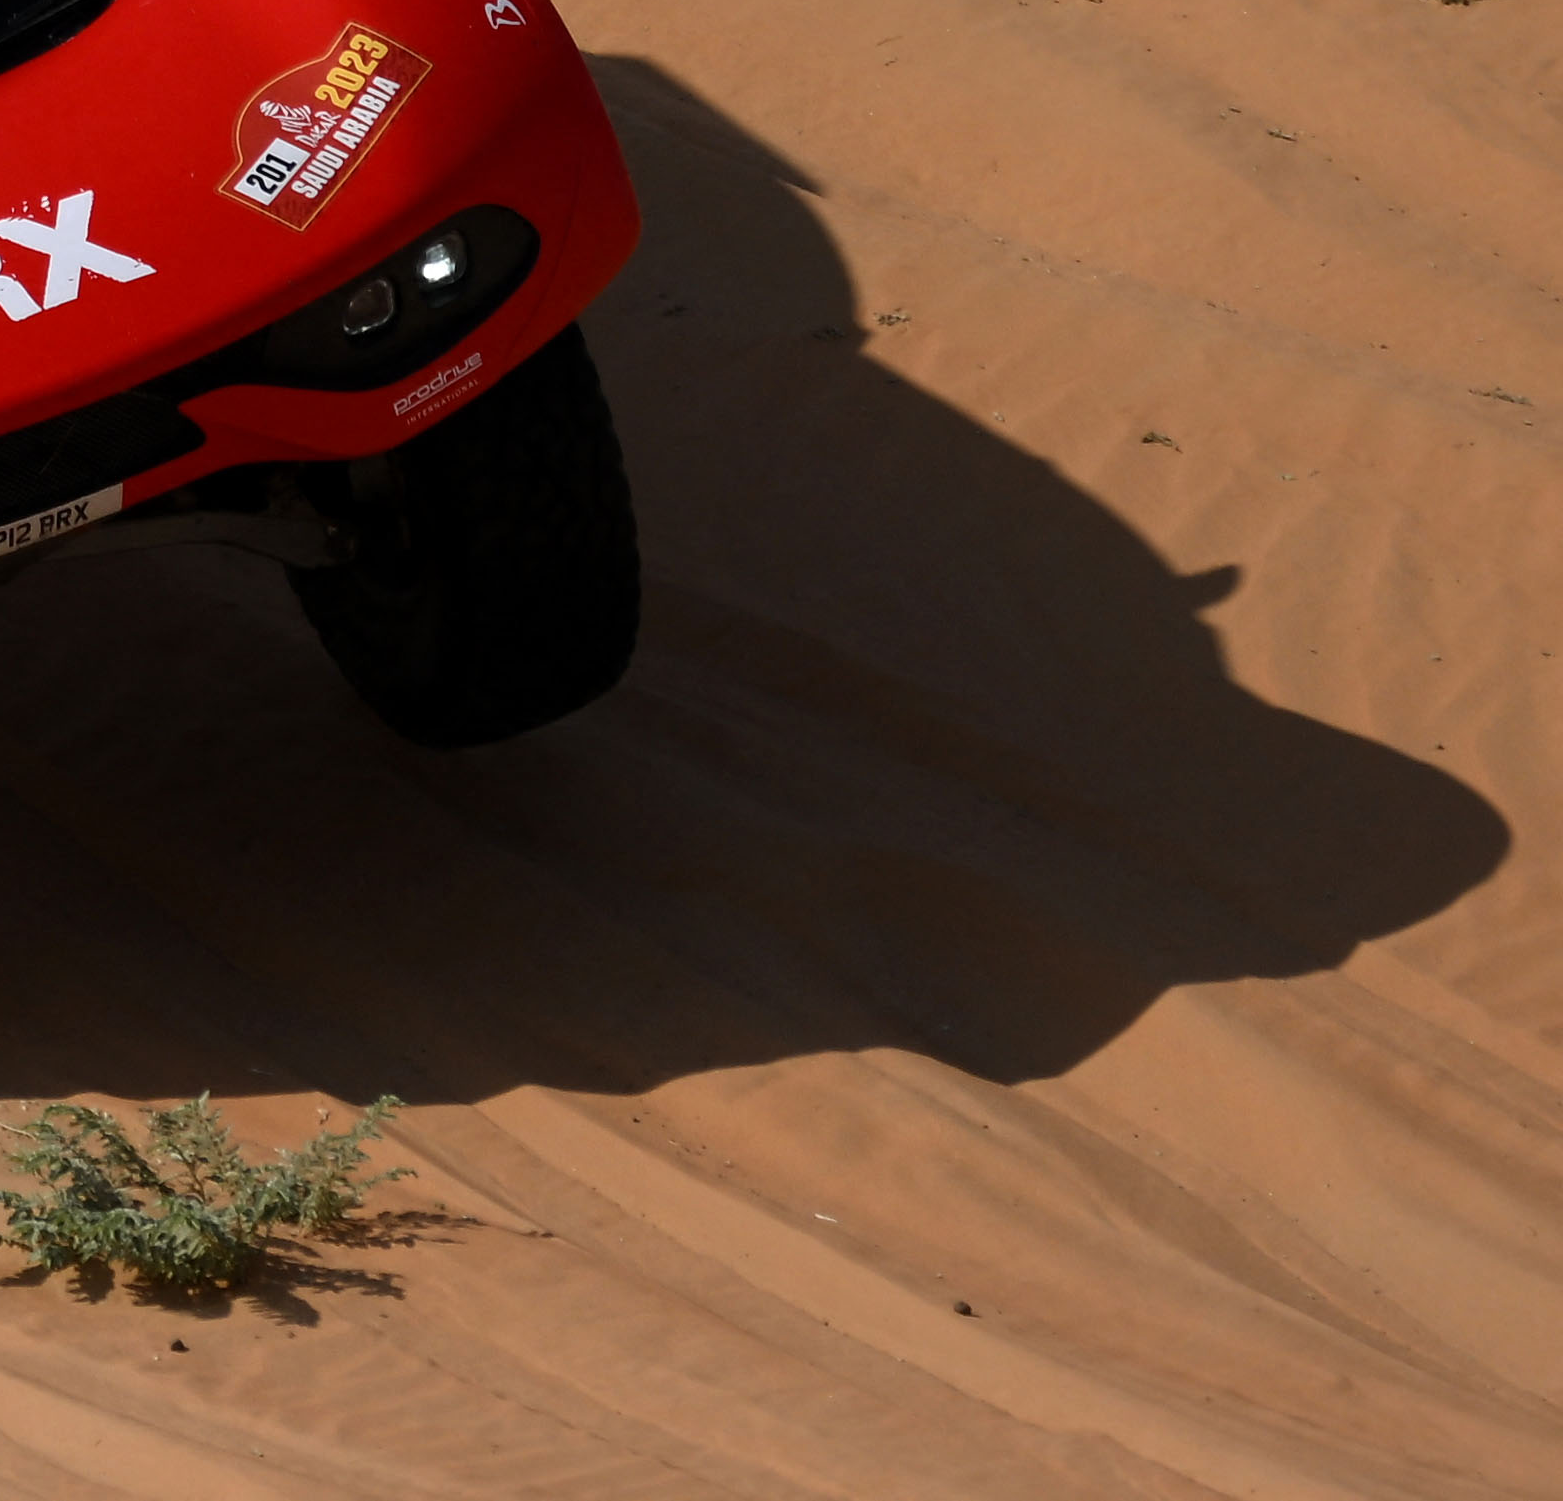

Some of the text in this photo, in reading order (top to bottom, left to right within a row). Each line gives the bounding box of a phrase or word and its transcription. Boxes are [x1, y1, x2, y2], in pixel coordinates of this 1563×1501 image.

[314, 33, 389, 110] 2023
[291, 75, 401, 199] SAUDI ARABIA
[294, 111, 341, 148] DAKAR
[246, 153, 297, 195] 201
[393, 352, 482, 416] prodrive
[406, 379, 478, 425] INTERNATIONAL
[39, 502, 89, 537] BRX
